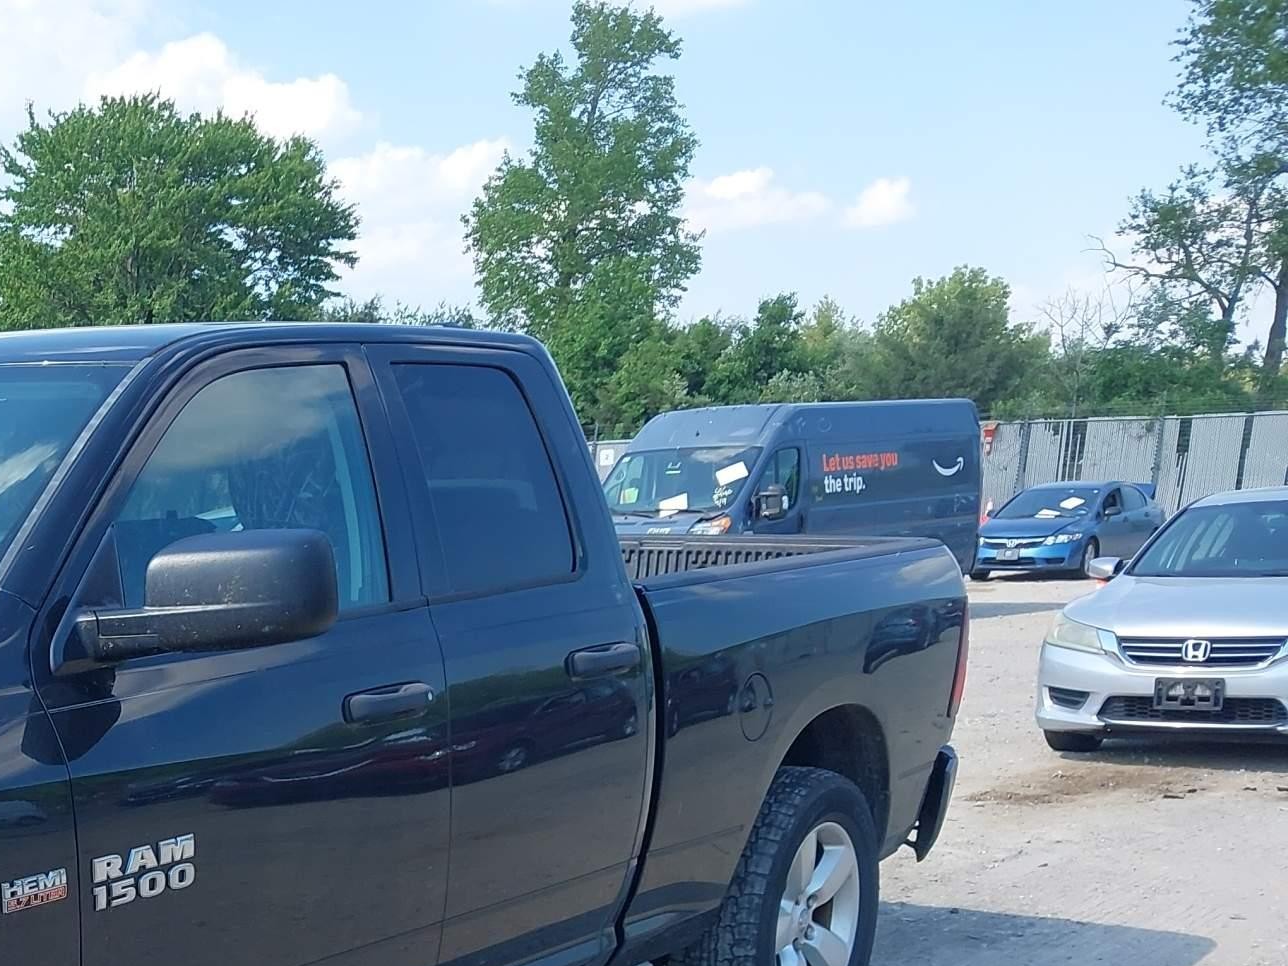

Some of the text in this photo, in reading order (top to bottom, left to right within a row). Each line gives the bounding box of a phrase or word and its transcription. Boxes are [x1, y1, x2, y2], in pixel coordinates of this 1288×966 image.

[822, 451, 898, 472] Let us save you
[824, 471, 866, 494] the trip.
[91, 833, 195, 884] RAM
[1, 867, 67, 900] HEMI
[92, 862, 196, 912] 1500
